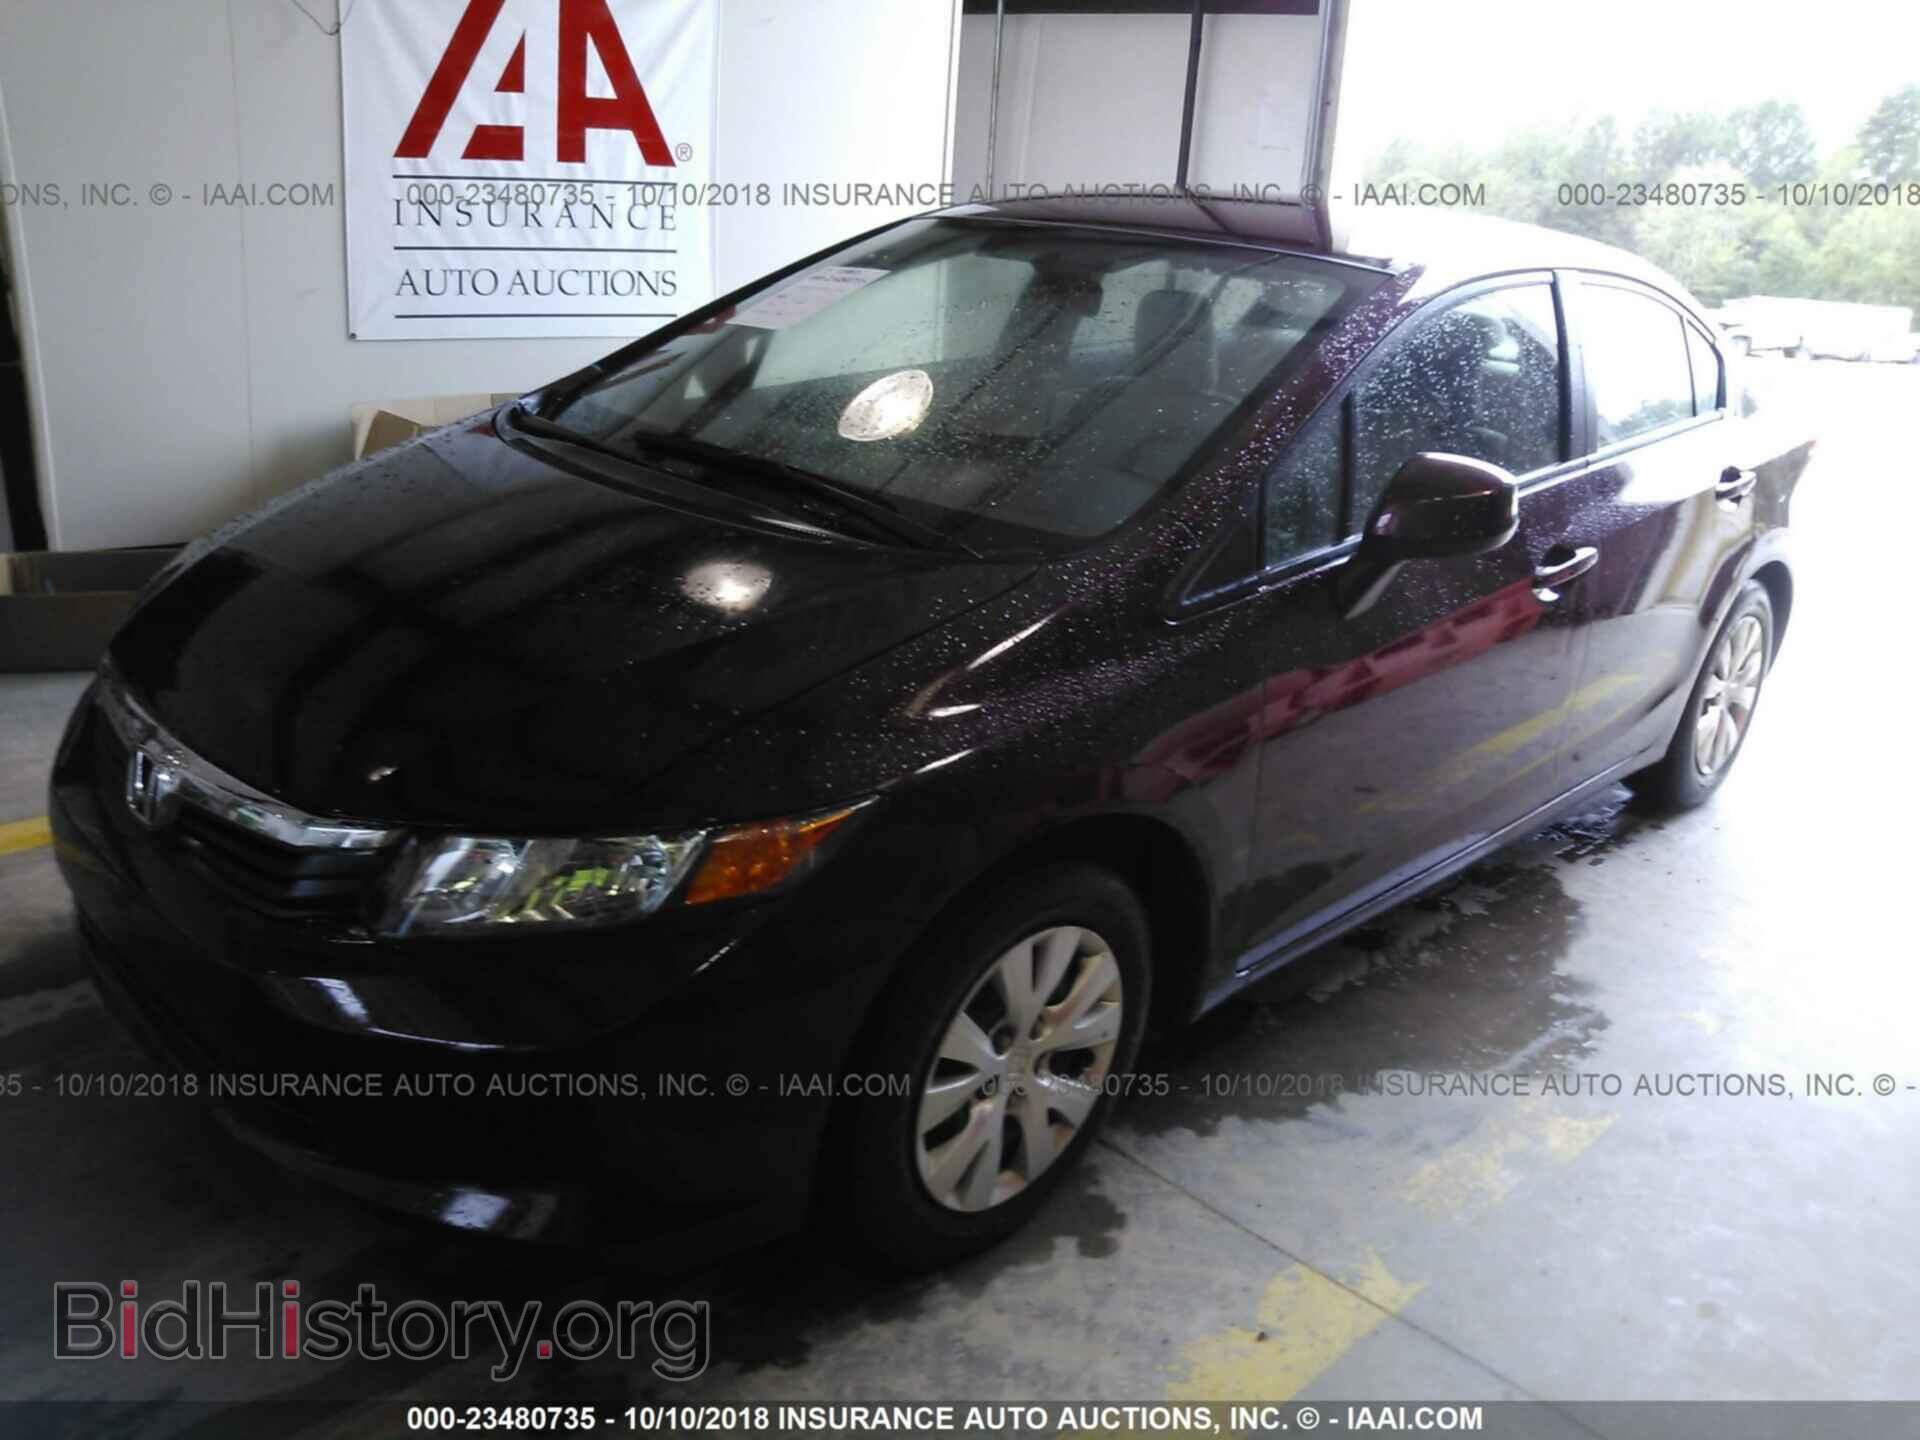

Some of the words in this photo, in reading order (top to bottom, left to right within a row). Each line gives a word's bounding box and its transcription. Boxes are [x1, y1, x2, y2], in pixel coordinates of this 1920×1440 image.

[393, 198, 677, 231] INSURANCE
[394, 267, 499, 297] AUTO
[506, 268, 678, 297] AUCTIONS
